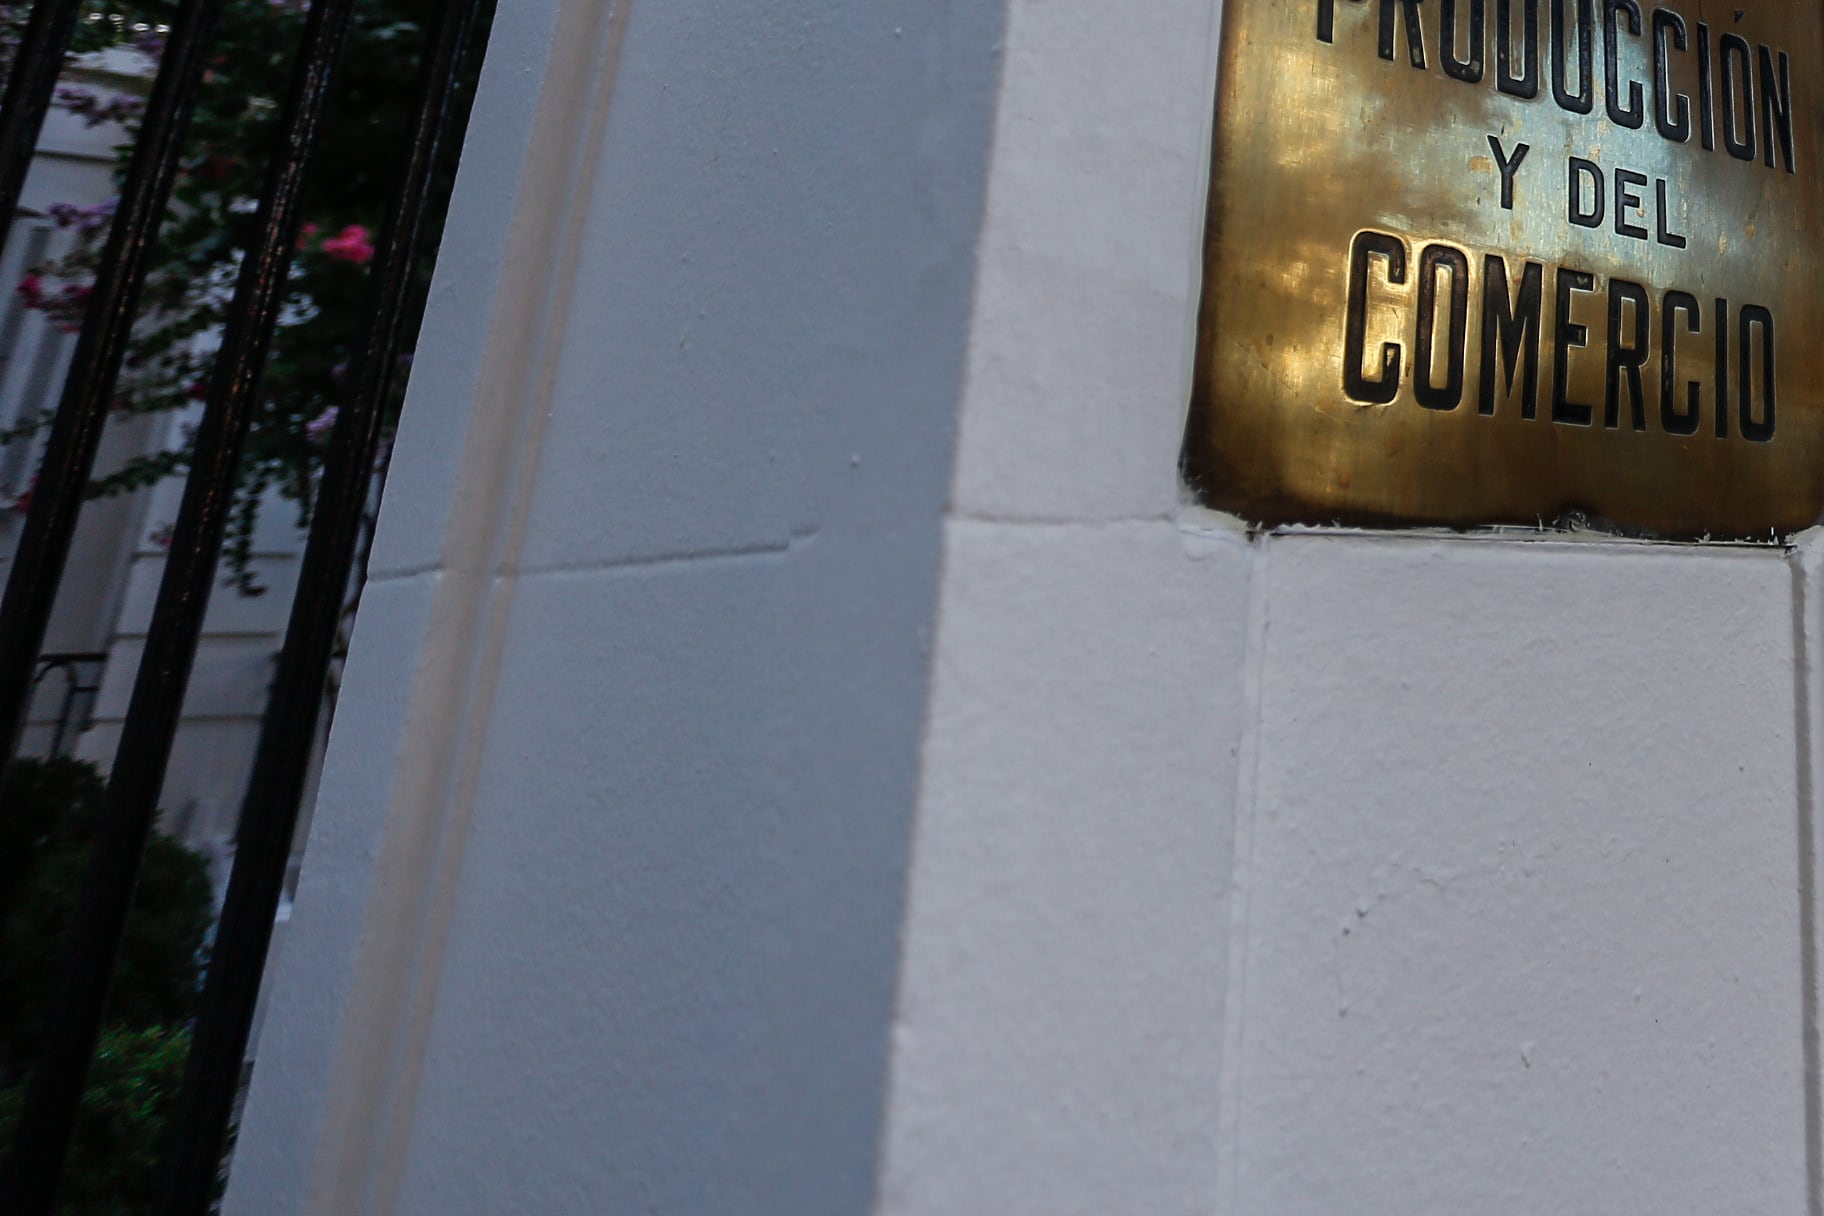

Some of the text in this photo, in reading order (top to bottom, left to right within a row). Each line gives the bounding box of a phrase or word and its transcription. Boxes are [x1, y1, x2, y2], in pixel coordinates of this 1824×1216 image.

[1487, 136, 1688, 249] Y DEL
[1343, 230, 1775, 443] COMERCIO
